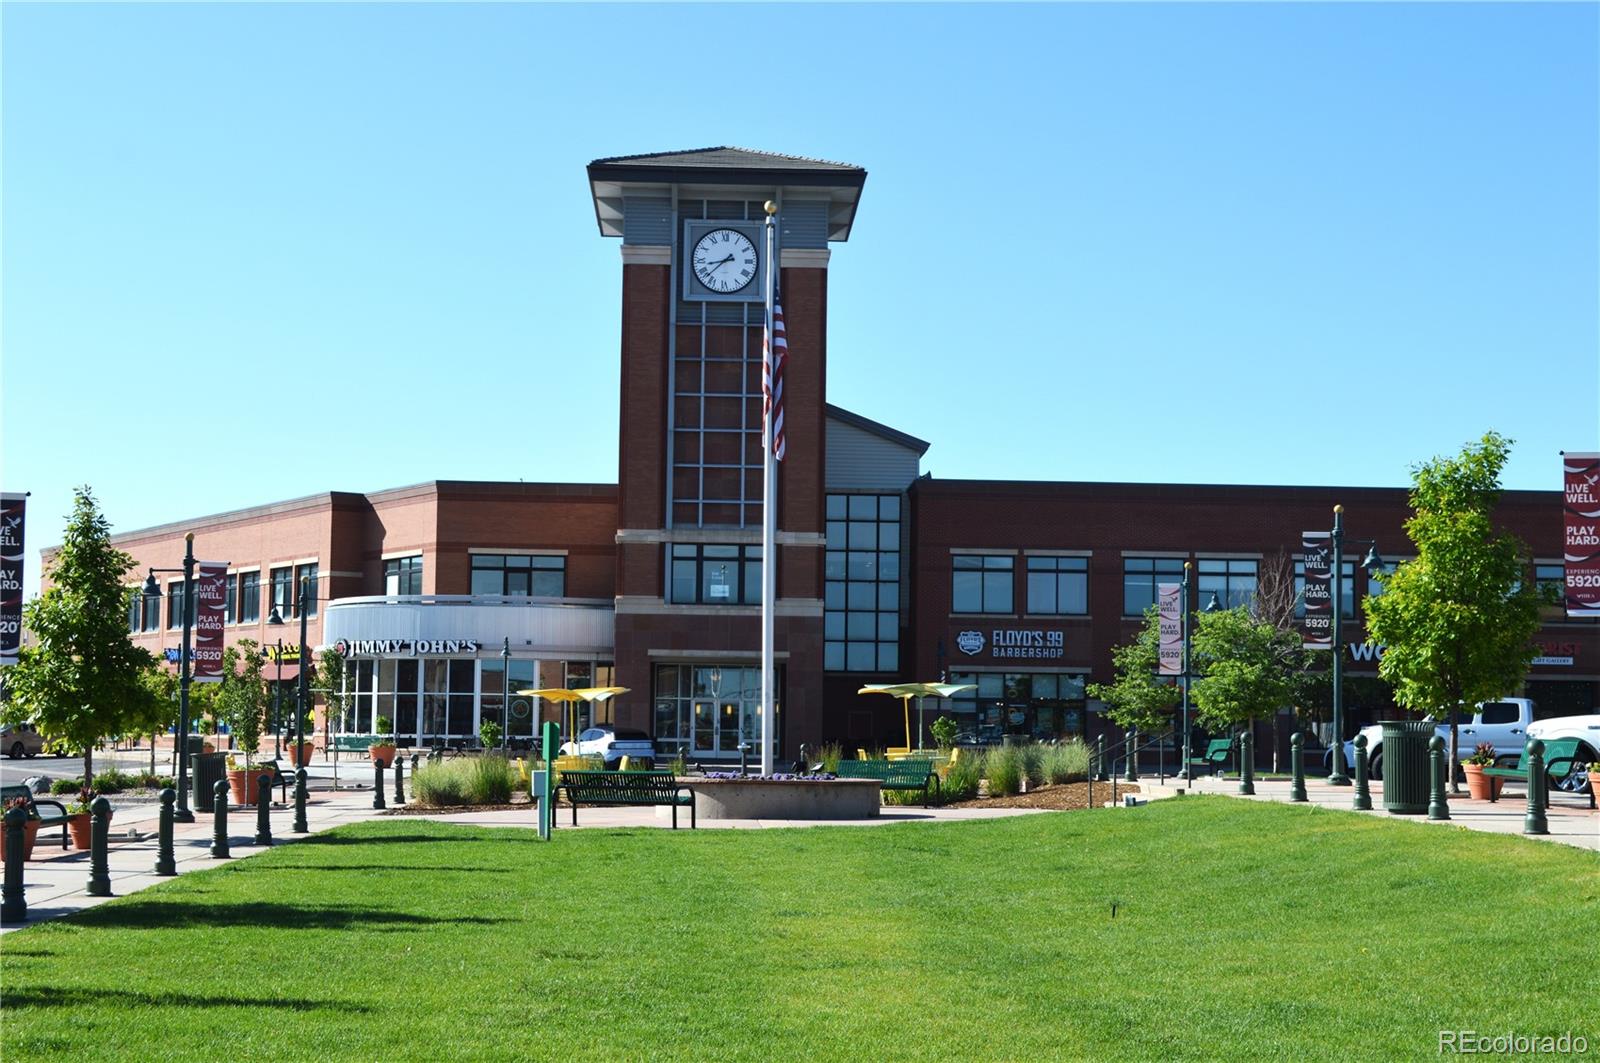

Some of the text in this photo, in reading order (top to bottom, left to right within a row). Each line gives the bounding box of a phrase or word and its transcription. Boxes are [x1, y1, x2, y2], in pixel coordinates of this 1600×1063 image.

[1566, 483, 1589, 493] LIVE
[1566, 493, 1598, 503] WELL.
[1566, 525, 1595, 535] PLAY
[0, 536, 20, 546] ELL.
[1304, 554, 1321, 562] LIVE
[1304, 561, 1328, 569] WELL.
[0, 569, 15, 580] AY
[199, 584, 217, 592] LIVE
[199, 591, 223, 600] WELL.
[1305, 591, 1331, 599] HARD.
[198, 615, 219, 623] PLAY
[198, 622, 224, 630] HARD.
[992, 630, 1064, 647] FLOYD'S 99
[349, 639, 478, 658] JIMMY JOHN'S
[992, 648, 1064, 658] BARBERSHOP
